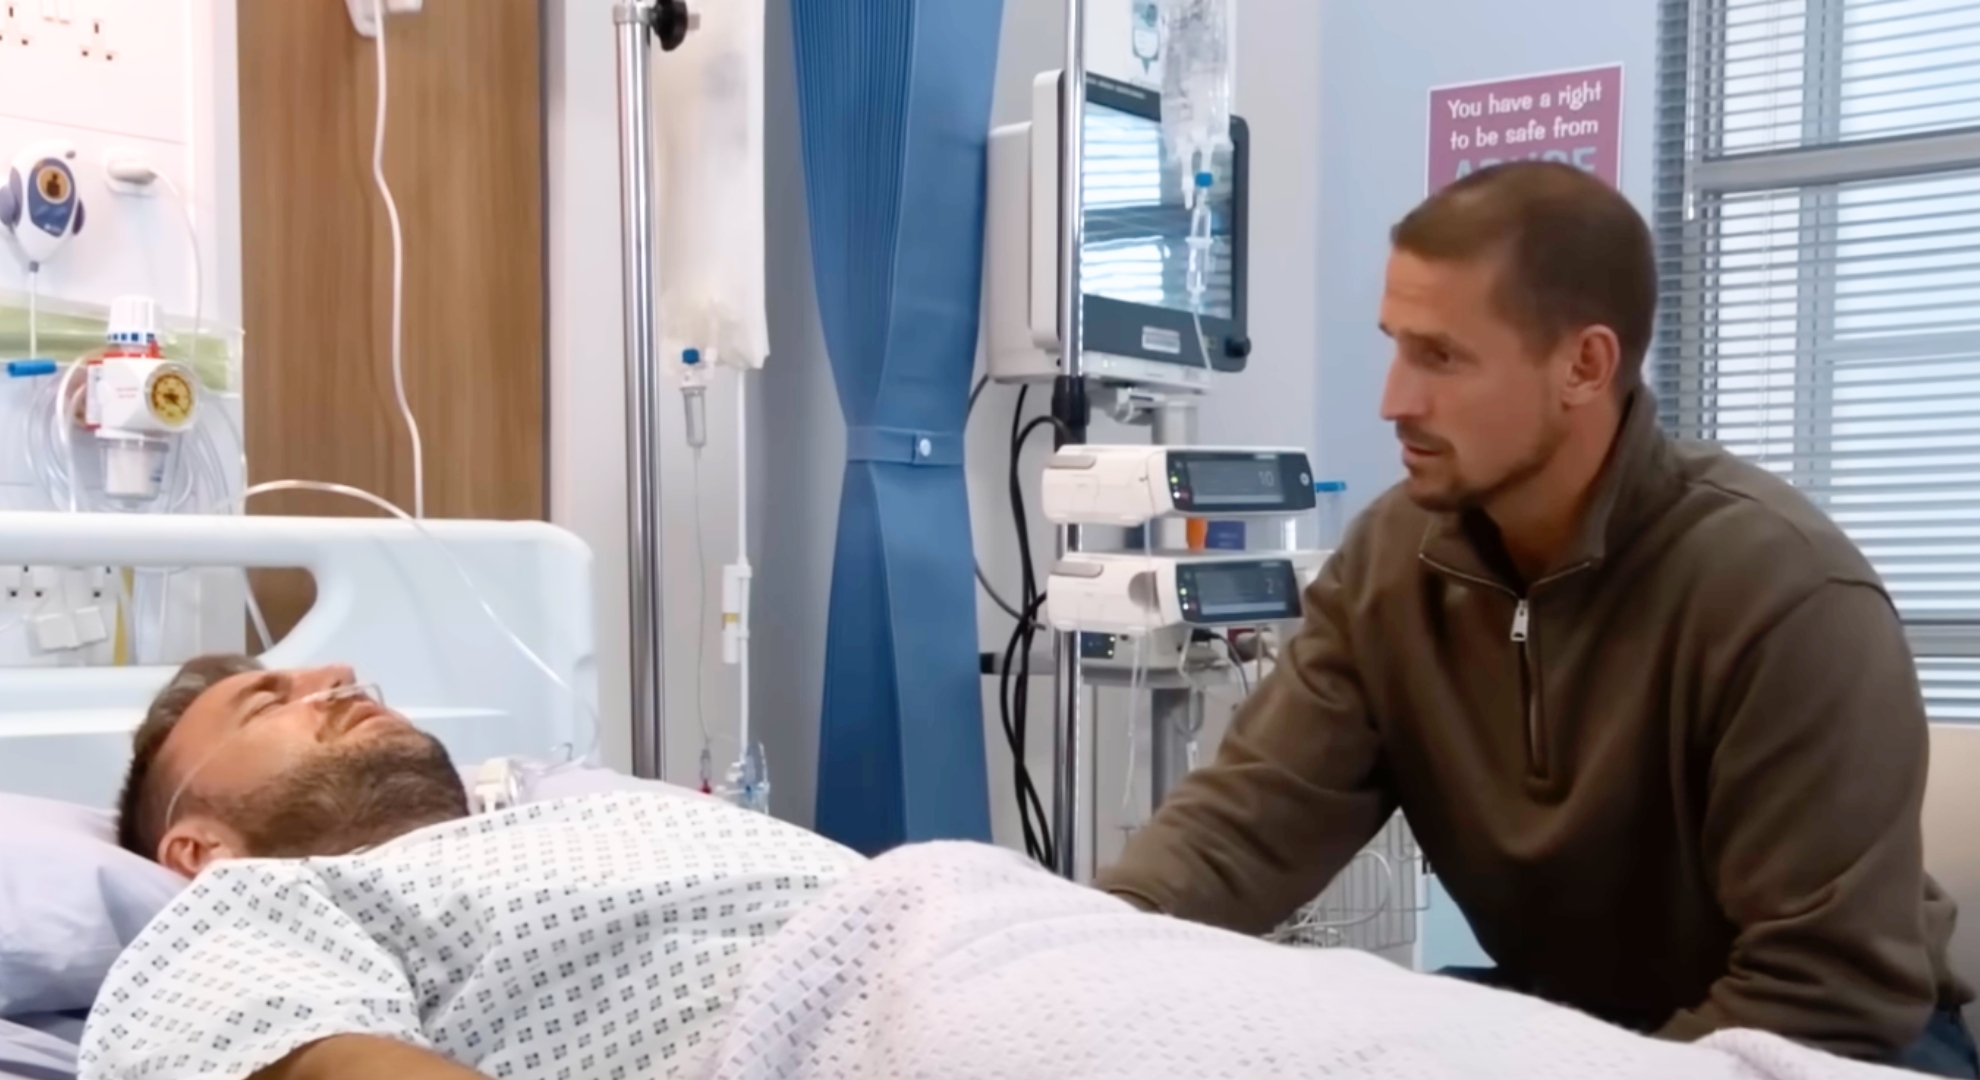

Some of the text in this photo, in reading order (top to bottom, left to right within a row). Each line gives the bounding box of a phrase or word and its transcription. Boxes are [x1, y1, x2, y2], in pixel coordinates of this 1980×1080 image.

[1447, 80, 1603, 119] You have a right
[1450, 116, 1599, 150] to be safe from
